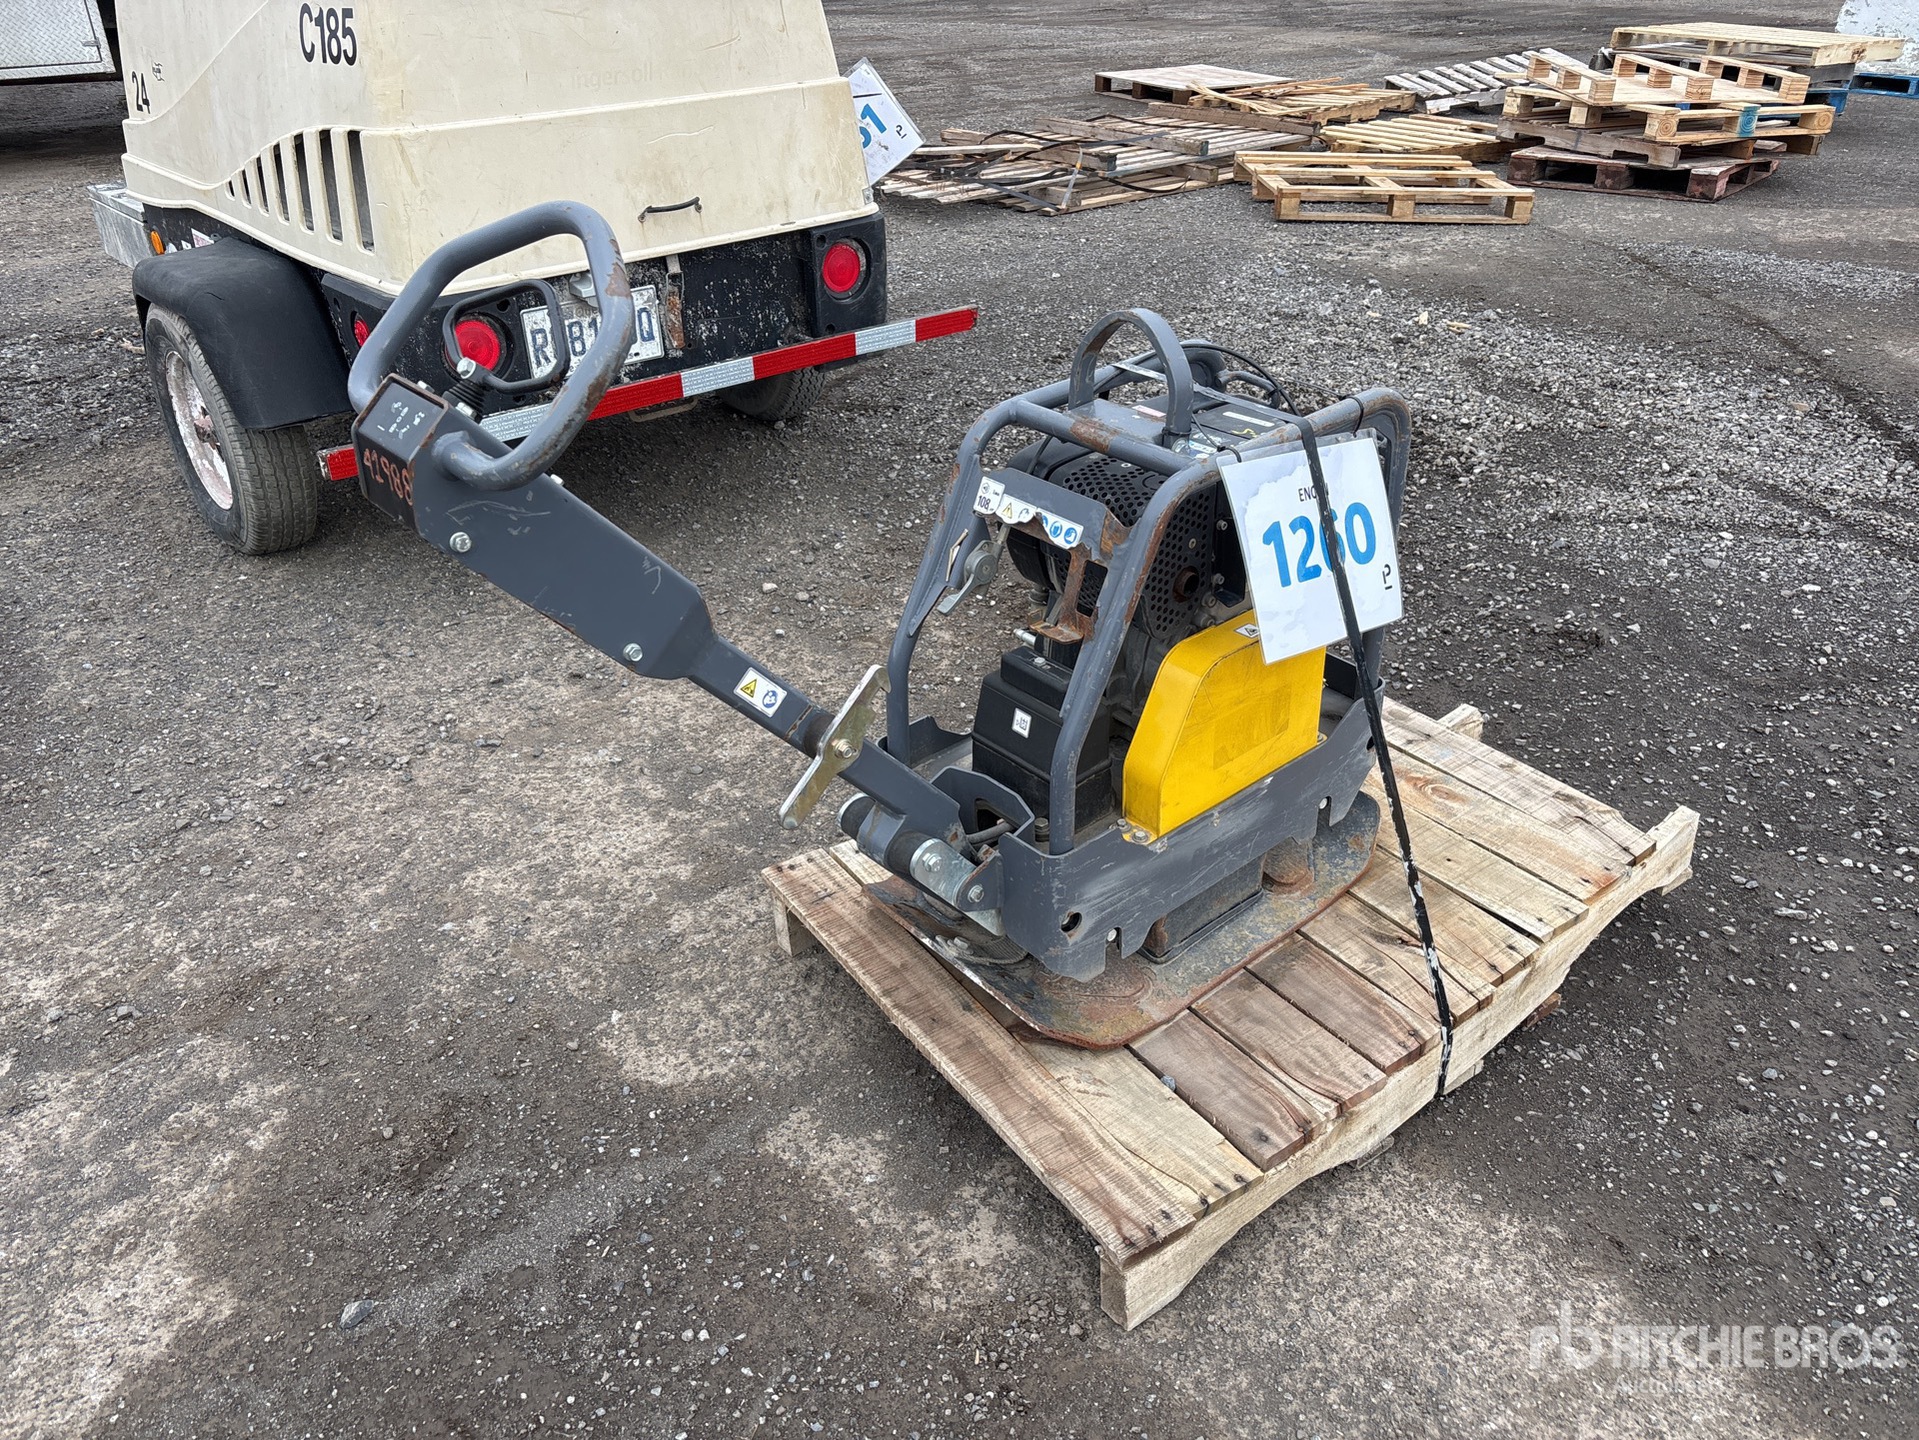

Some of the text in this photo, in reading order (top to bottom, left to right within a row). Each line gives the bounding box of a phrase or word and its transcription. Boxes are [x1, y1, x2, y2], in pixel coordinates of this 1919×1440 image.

[299, 2, 357, 67] C185
[131, 70, 151, 115] 24
[977, 495, 992, 512] 108
[1262, 502, 1377, 588] 1260
